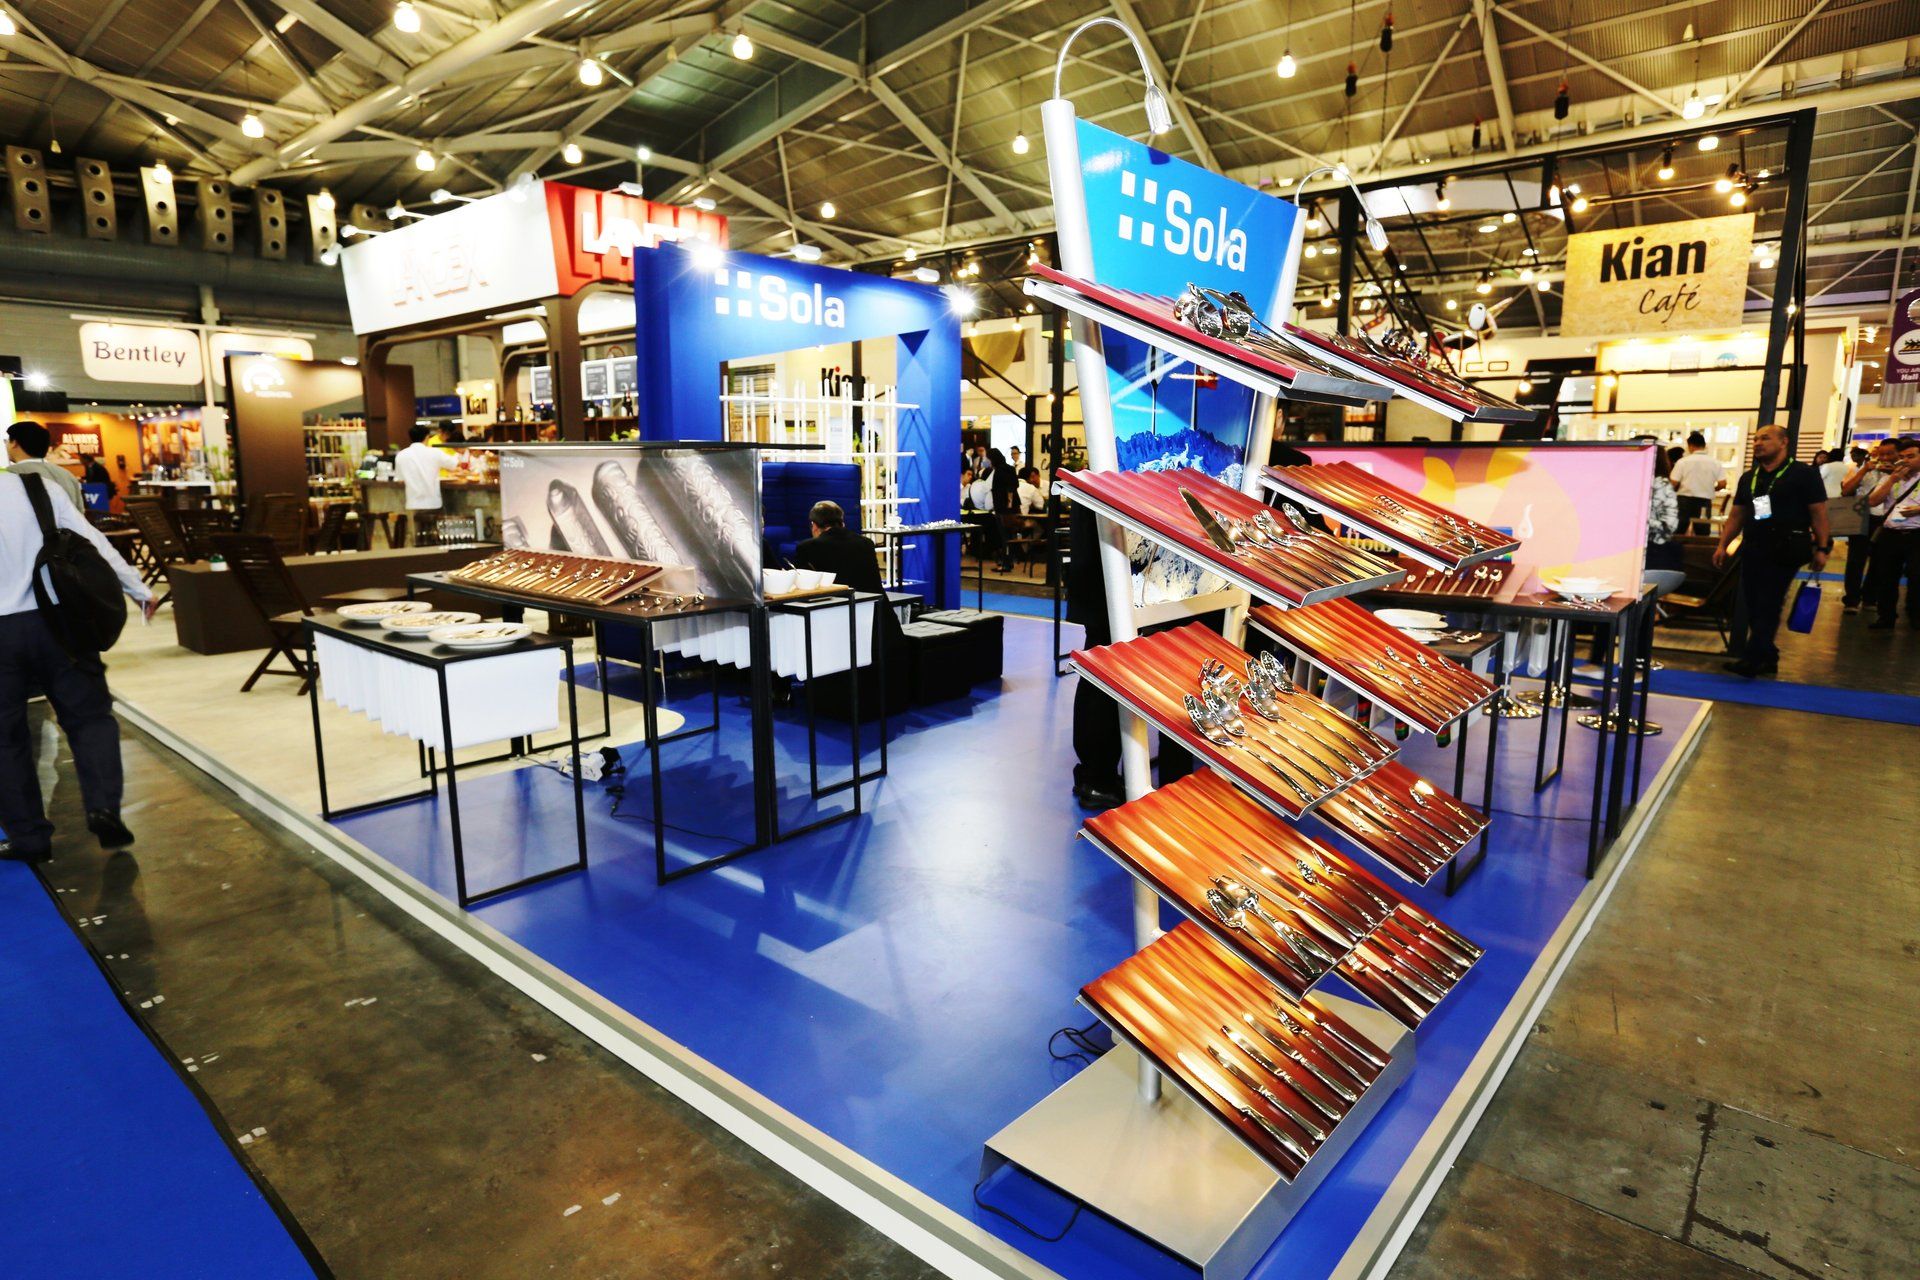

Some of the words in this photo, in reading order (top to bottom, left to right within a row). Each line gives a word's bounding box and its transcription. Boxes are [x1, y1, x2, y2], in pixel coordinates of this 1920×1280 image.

[1163, 189, 1247, 272] Sola
[1600, 236, 1707, 283] Kian
[759, 275, 845, 328] Sola
[1639, 283, 1701, 323] Café
[93, 340, 186, 368] Bentley
[62, 433, 99, 444] ALWAYS
